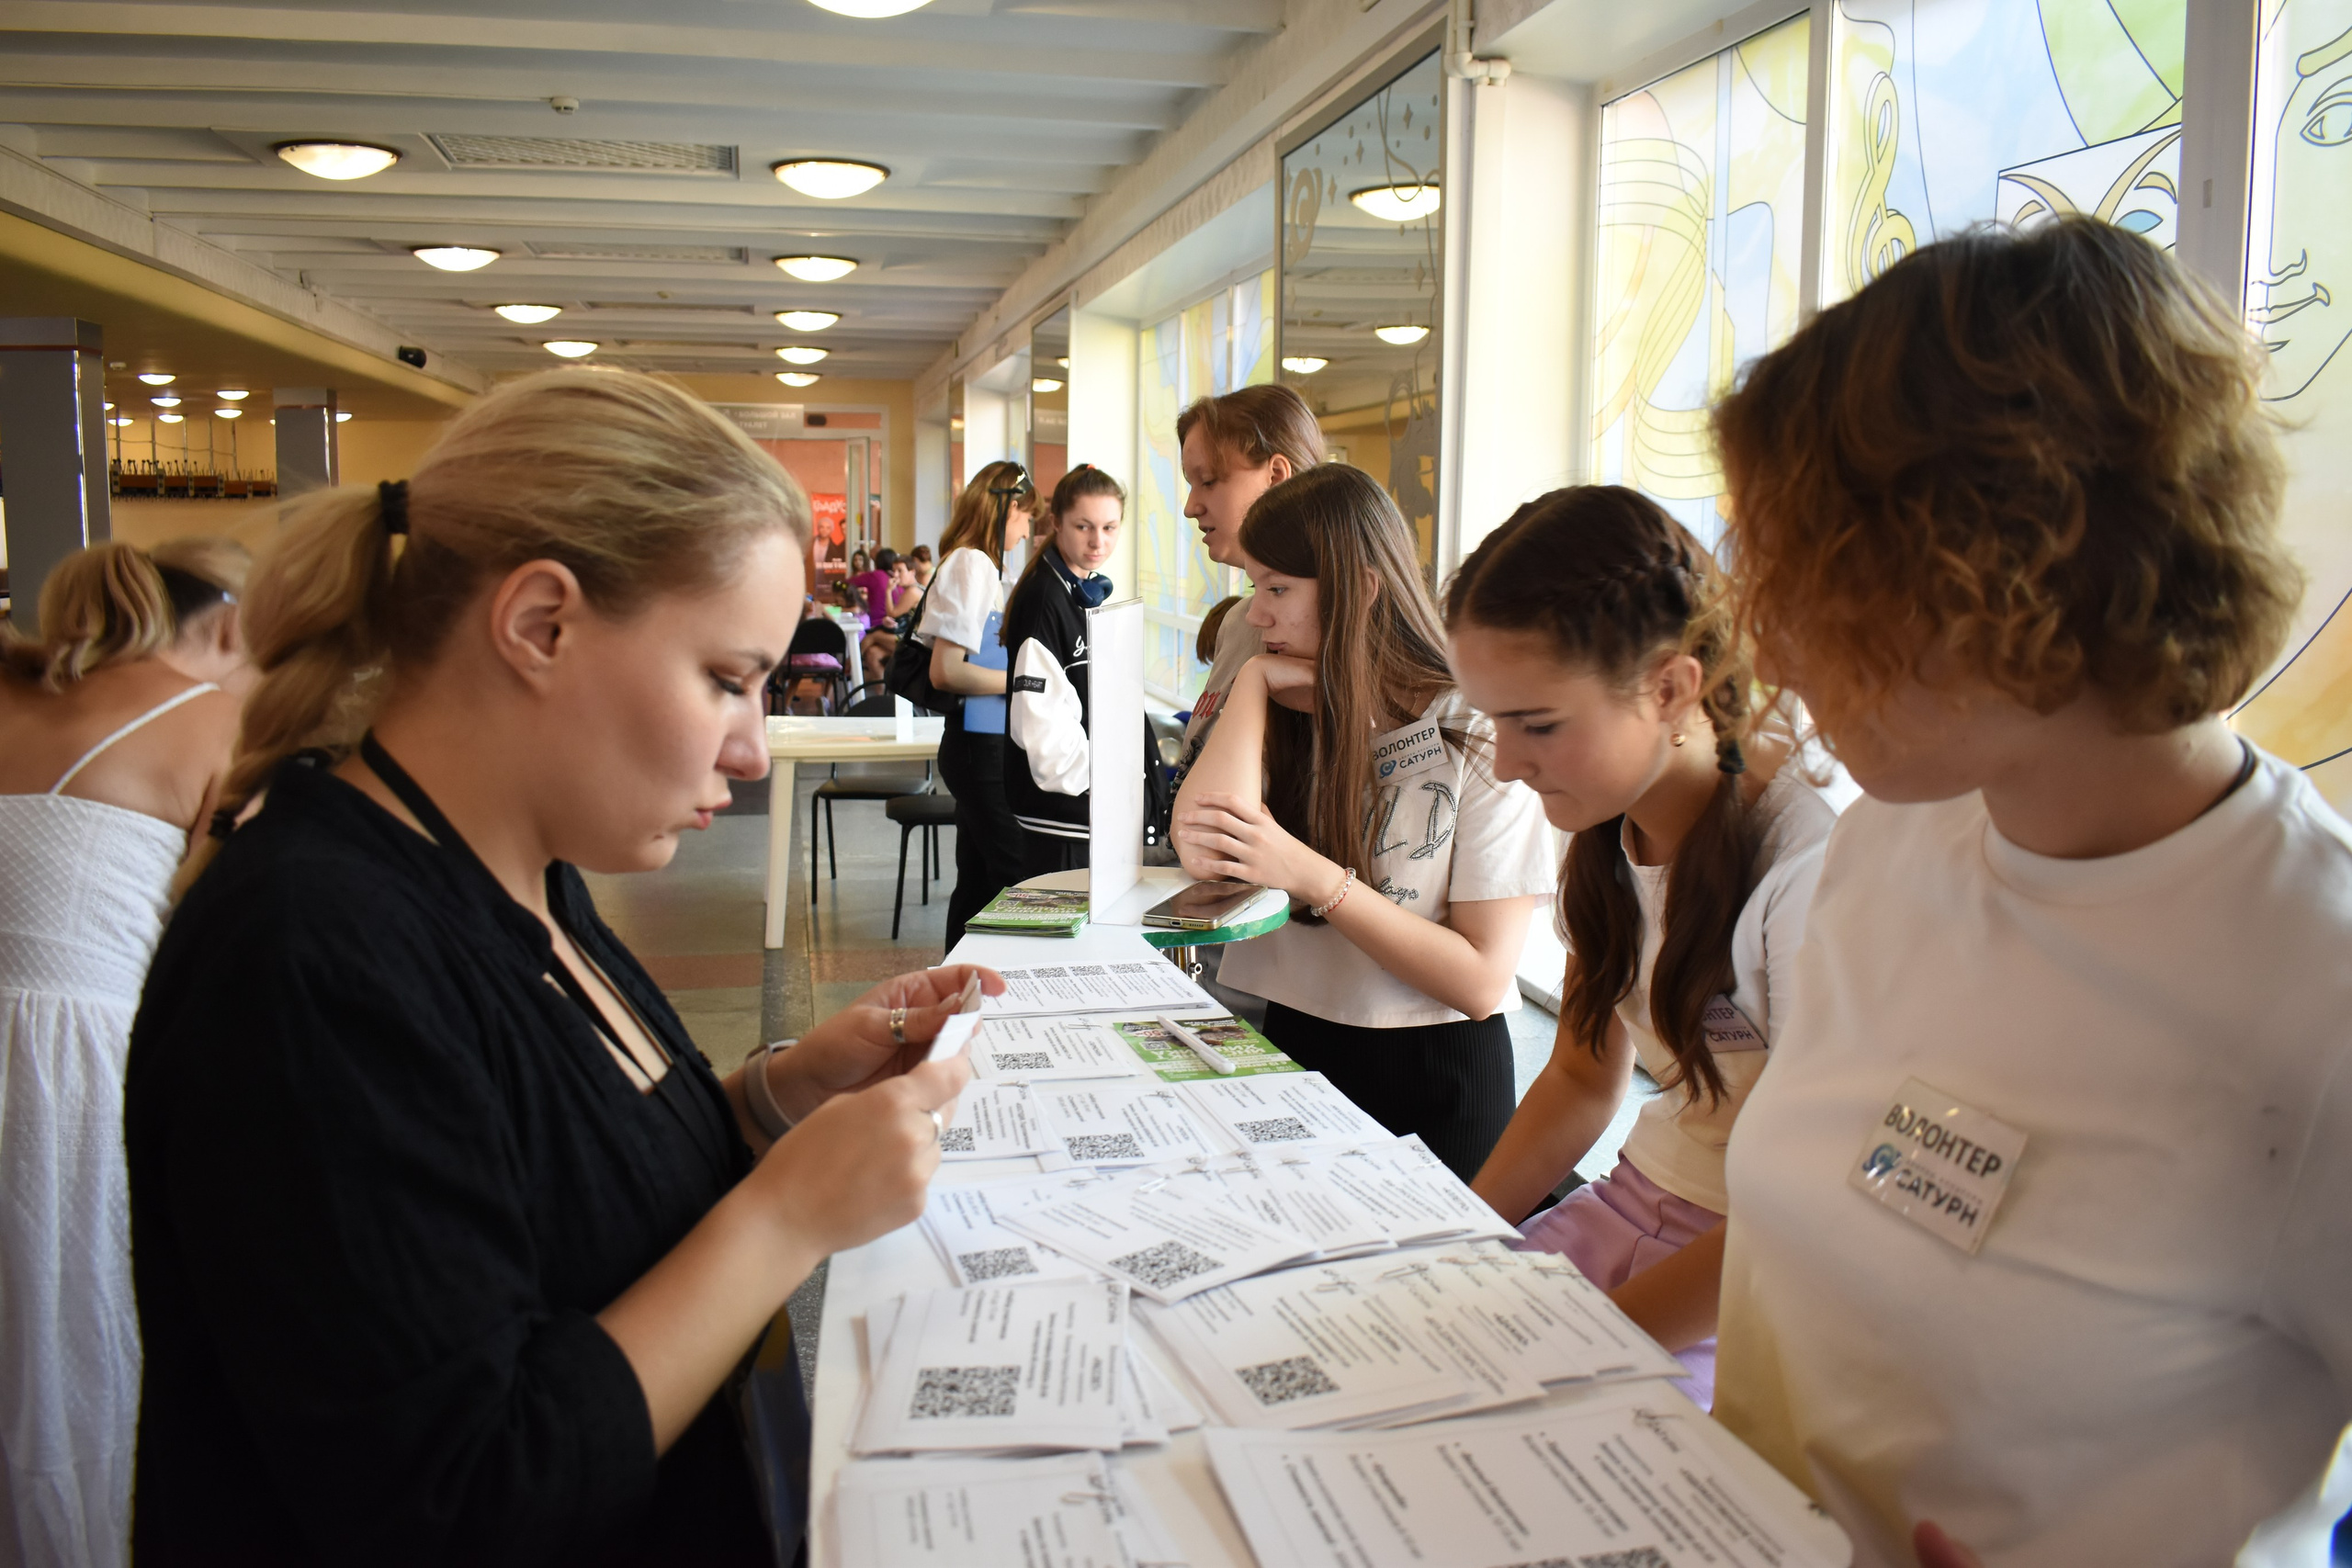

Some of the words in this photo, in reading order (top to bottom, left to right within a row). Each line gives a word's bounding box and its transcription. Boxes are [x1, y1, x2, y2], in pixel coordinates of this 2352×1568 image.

[1373, 727, 1436, 761] ВОЛОНТЕР
[1399, 746, 1442, 769] САТУРН
[1709, 1030, 1754, 1043] САТУРН
[1883, 1103, 2003, 1179] ВОЛОНТЕР
[1895, 1169, 1980, 1227] САТУРН
